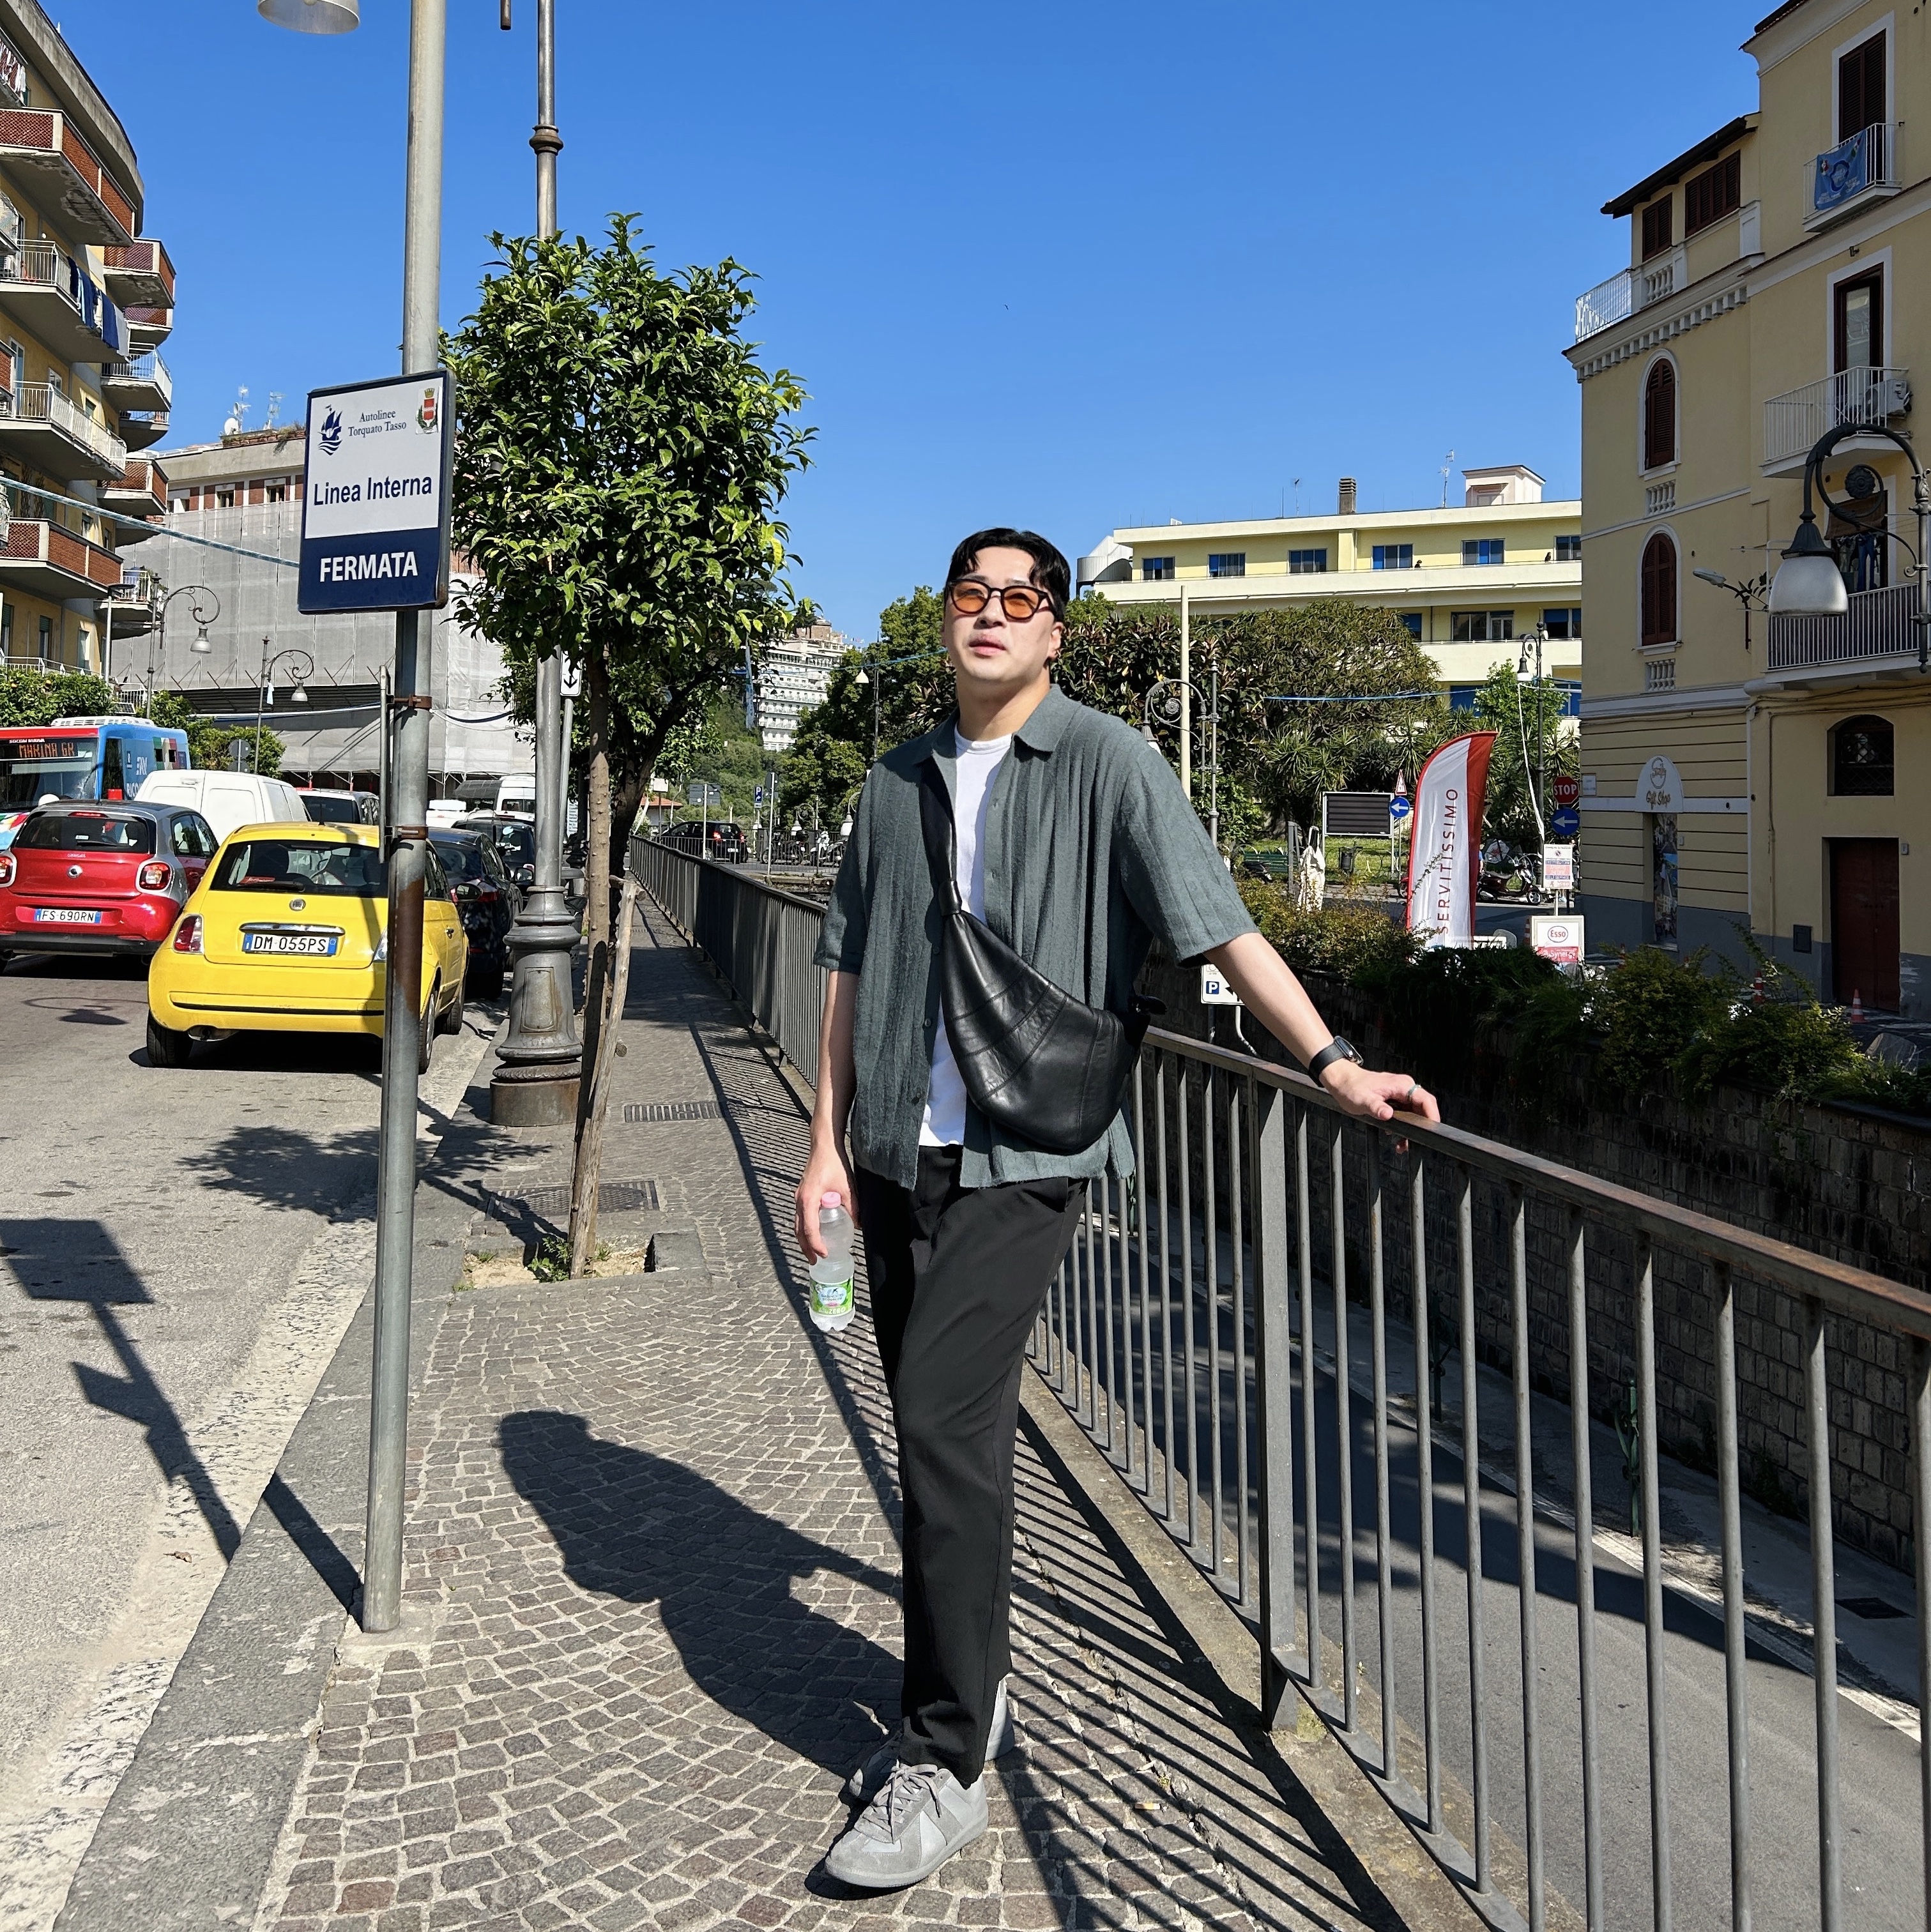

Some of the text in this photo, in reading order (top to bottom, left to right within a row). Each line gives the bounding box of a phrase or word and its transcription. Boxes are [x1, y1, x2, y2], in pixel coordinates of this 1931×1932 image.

[359, 409, 396, 423] Autolinee
[348, 421, 407, 438] Torquato Tasso
[314, 475, 432, 506] Linea Interna
[319, 551, 418, 582] FERMATA
[1553, 785, 1578, 796] STOP
[1657, 789, 1671, 809] Shop
[1437, 788, 1458, 934] SERVITISSIMO
[42, 910, 95, 922] FS 690RN
[1550, 929, 1566, 938] Esso
[254, 936, 326, 952] DM 055PS
[1209, 982, 1218, 994] P
